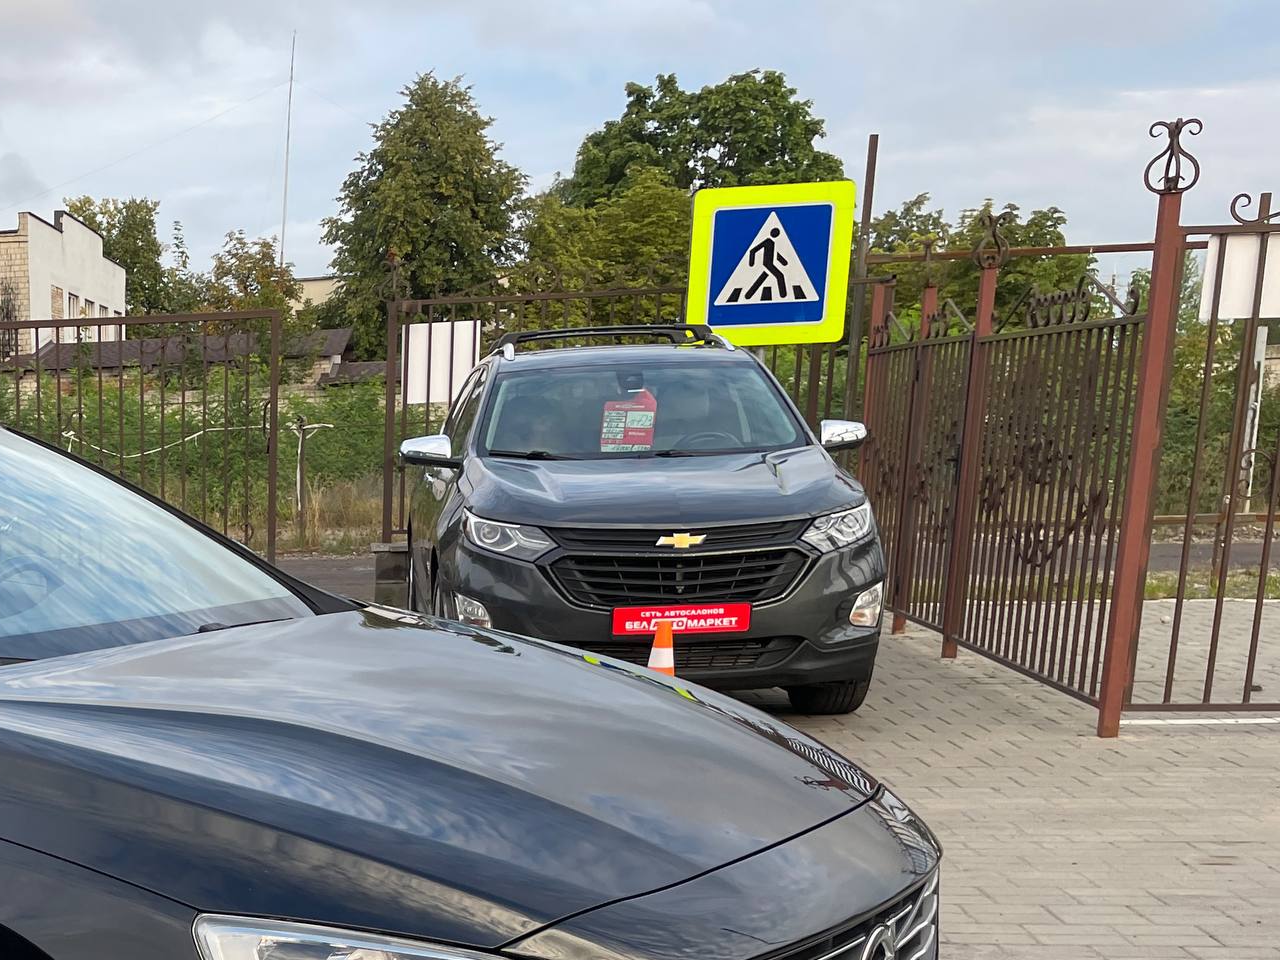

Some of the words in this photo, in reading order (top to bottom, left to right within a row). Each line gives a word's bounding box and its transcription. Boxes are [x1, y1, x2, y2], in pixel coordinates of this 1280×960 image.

[640, 610, 662, 618] СЕТЬ
[664, 607, 725, 617] АВТОСАЛОНОВ
[624, 616, 739, 631] БЕЛОМАРКЕТ
